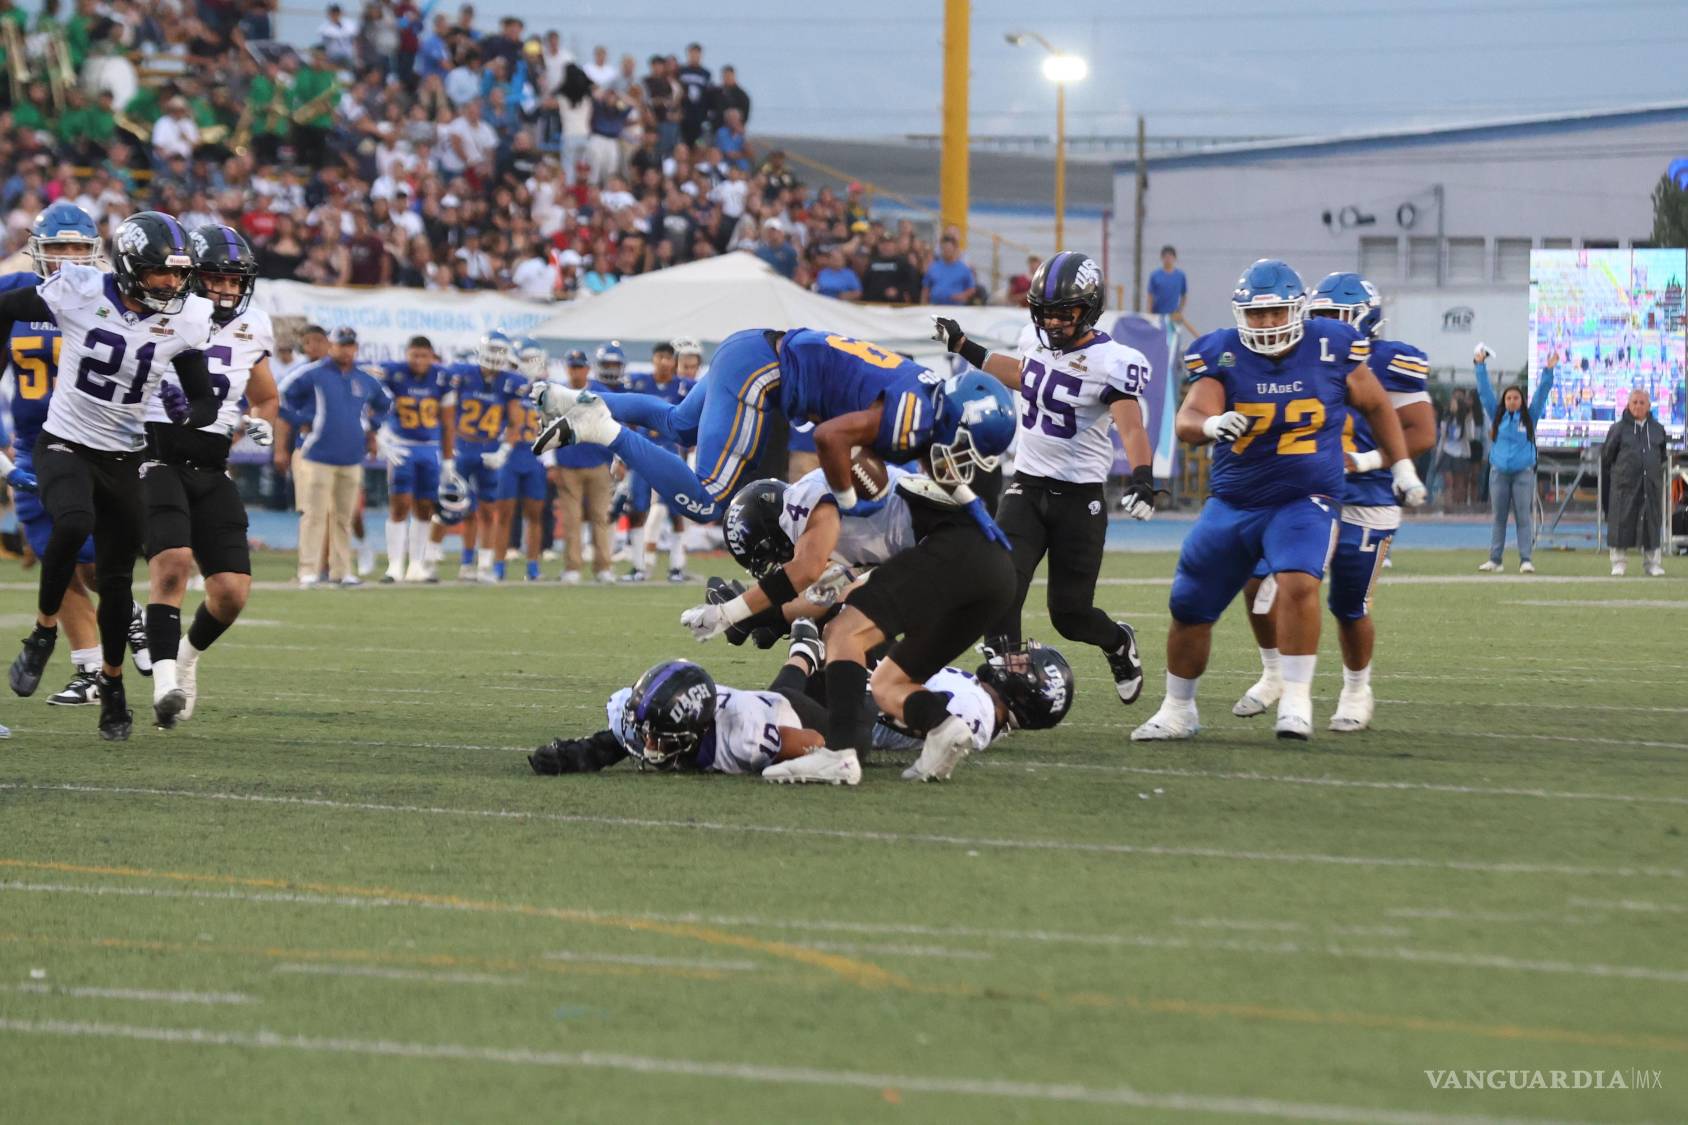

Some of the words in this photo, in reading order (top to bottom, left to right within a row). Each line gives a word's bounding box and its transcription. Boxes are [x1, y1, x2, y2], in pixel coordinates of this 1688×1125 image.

[75, 327, 157, 404] 21
[1319, 337, 1336, 362] L
[458, 399, 503, 439] 24
[1021, 358, 1083, 440] 95
[1234, 398, 1326, 455] 72
[674, 493, 716, 516] PRO
[786, 503, 809, 522] 4
[670, 683, 712, 724] UACH
[759, 723, 781, 759] 10
